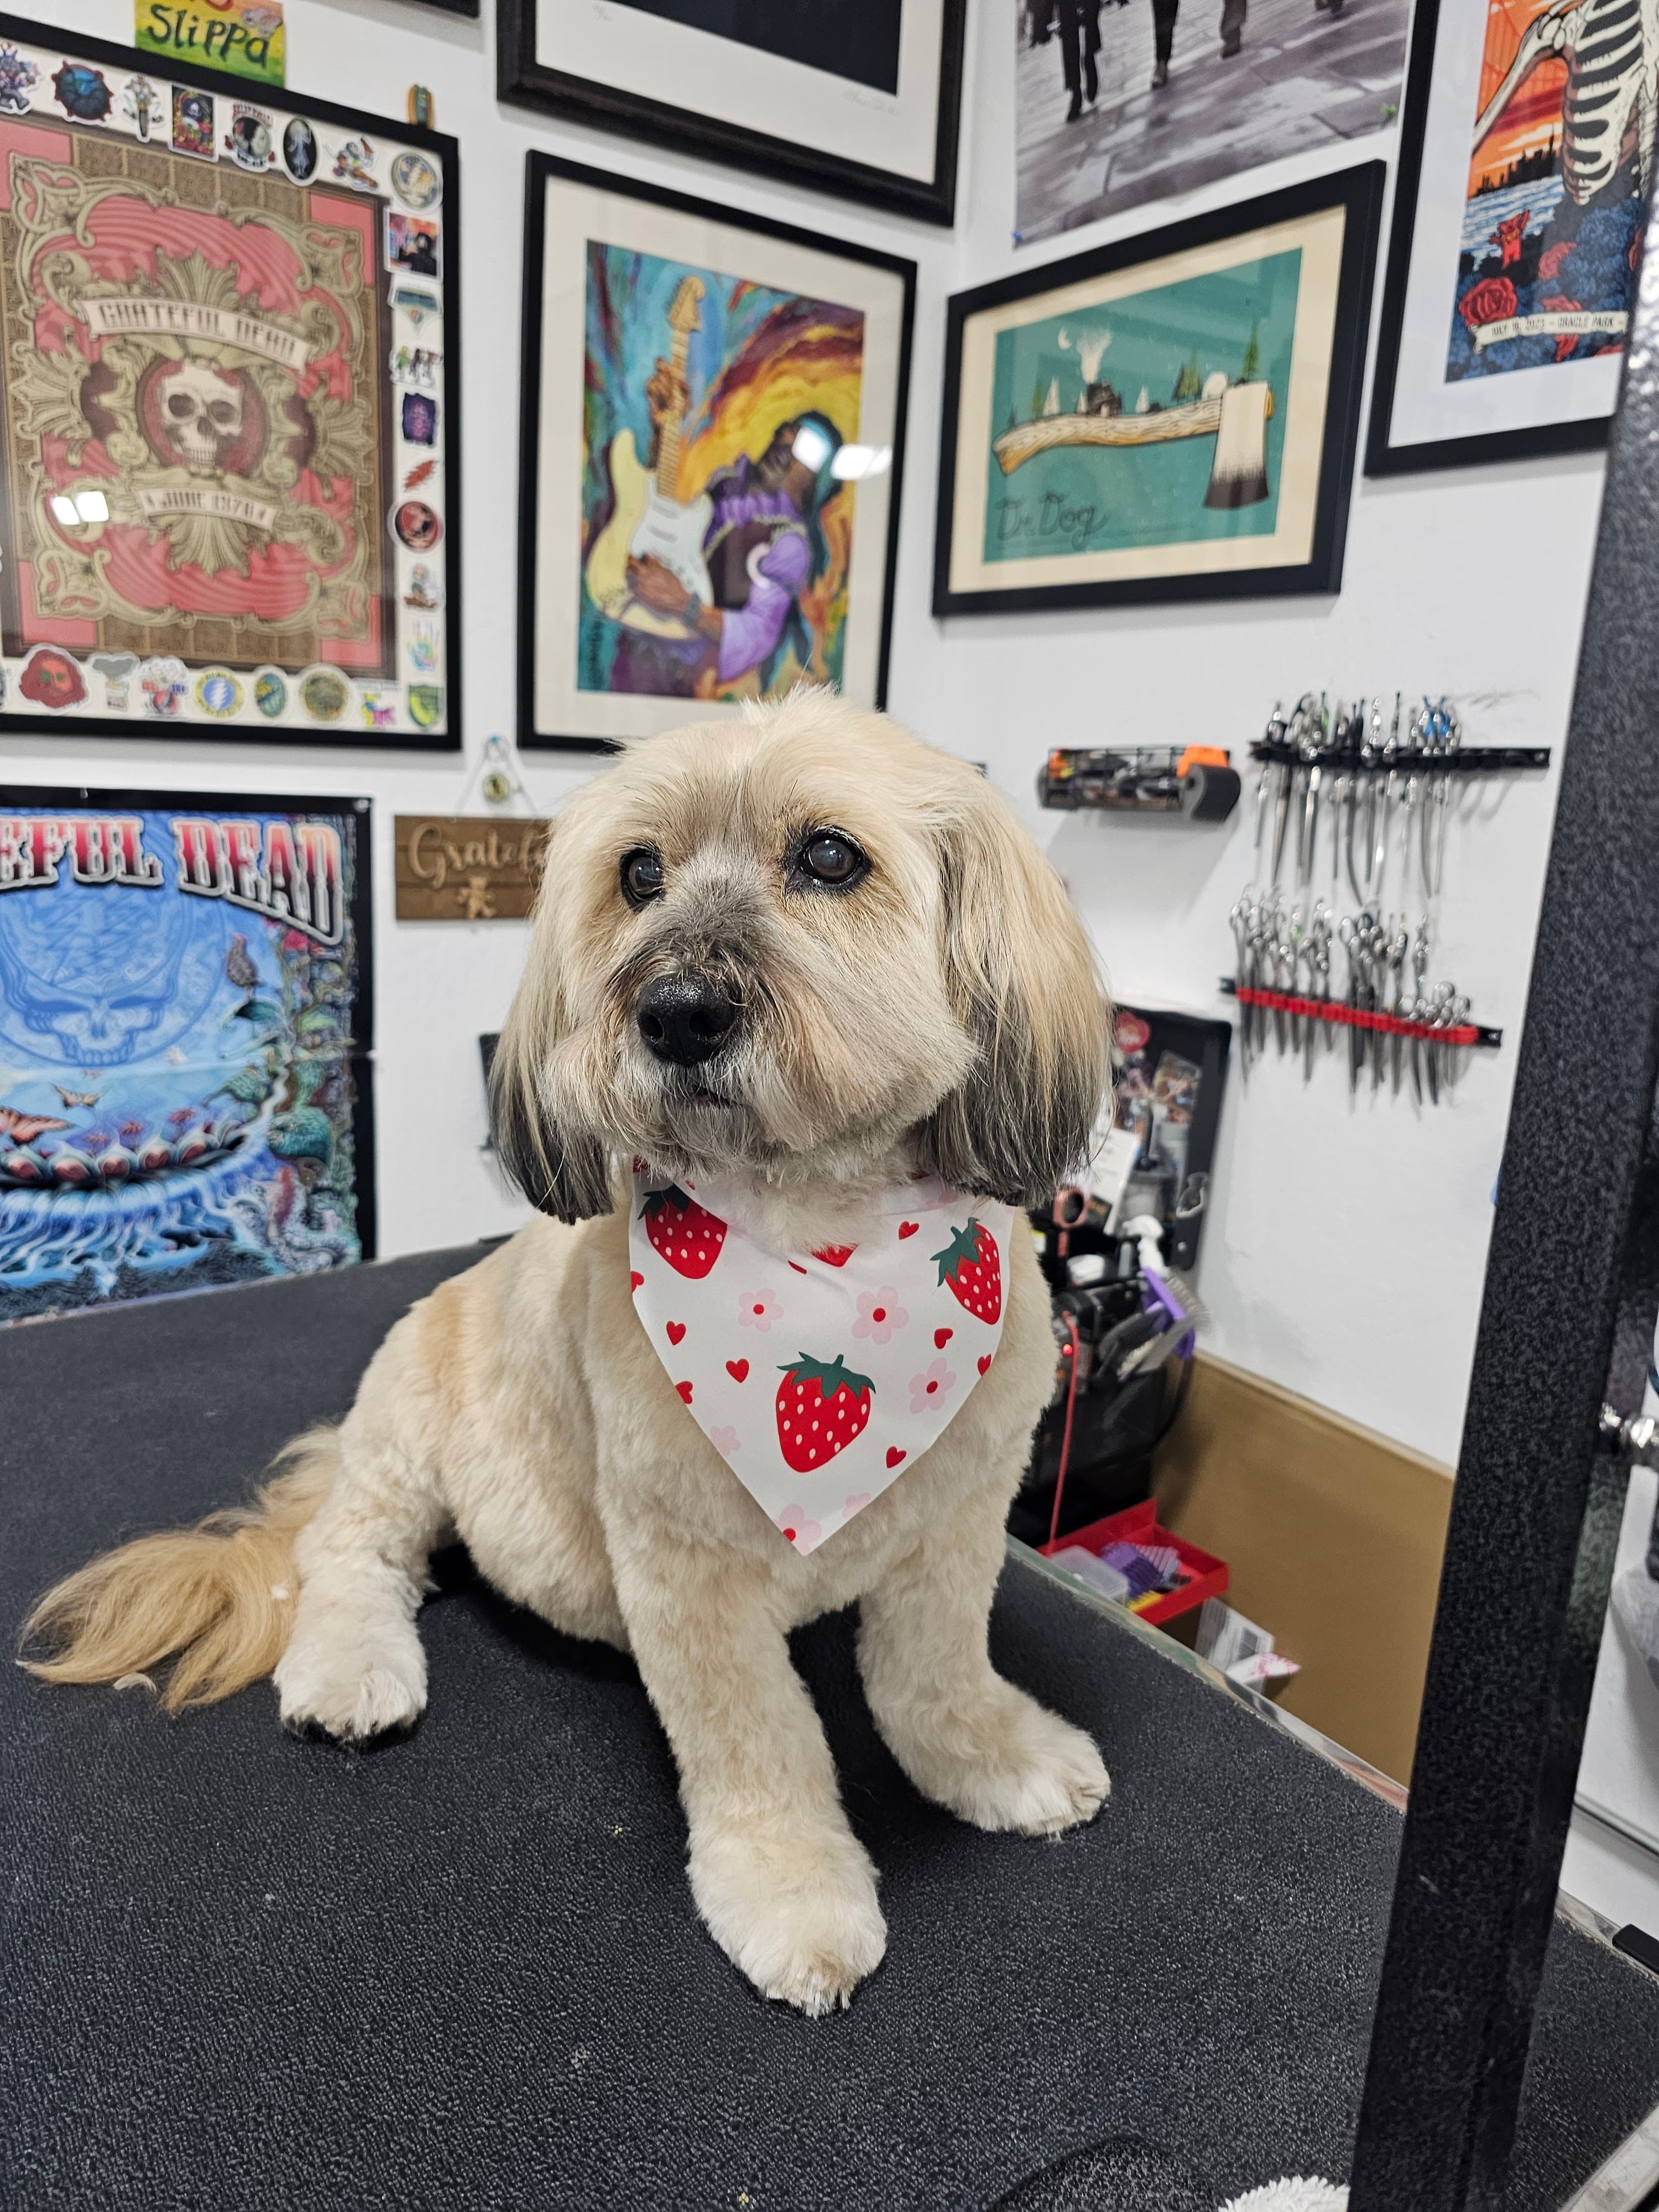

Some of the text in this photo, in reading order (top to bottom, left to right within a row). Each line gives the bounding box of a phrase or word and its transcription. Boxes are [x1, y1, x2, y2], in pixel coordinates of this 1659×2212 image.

[99, 303, 297, 360] GRATEFUL DEAD
[1557, 315, 1589, 328] ORACLE
[1592, 315, 1614, 328] PARK
[1038, 491, 1110, 551] Dog
[170, 817, 343, 945] DEAD
[409, 822, 546, 889] Gratef
